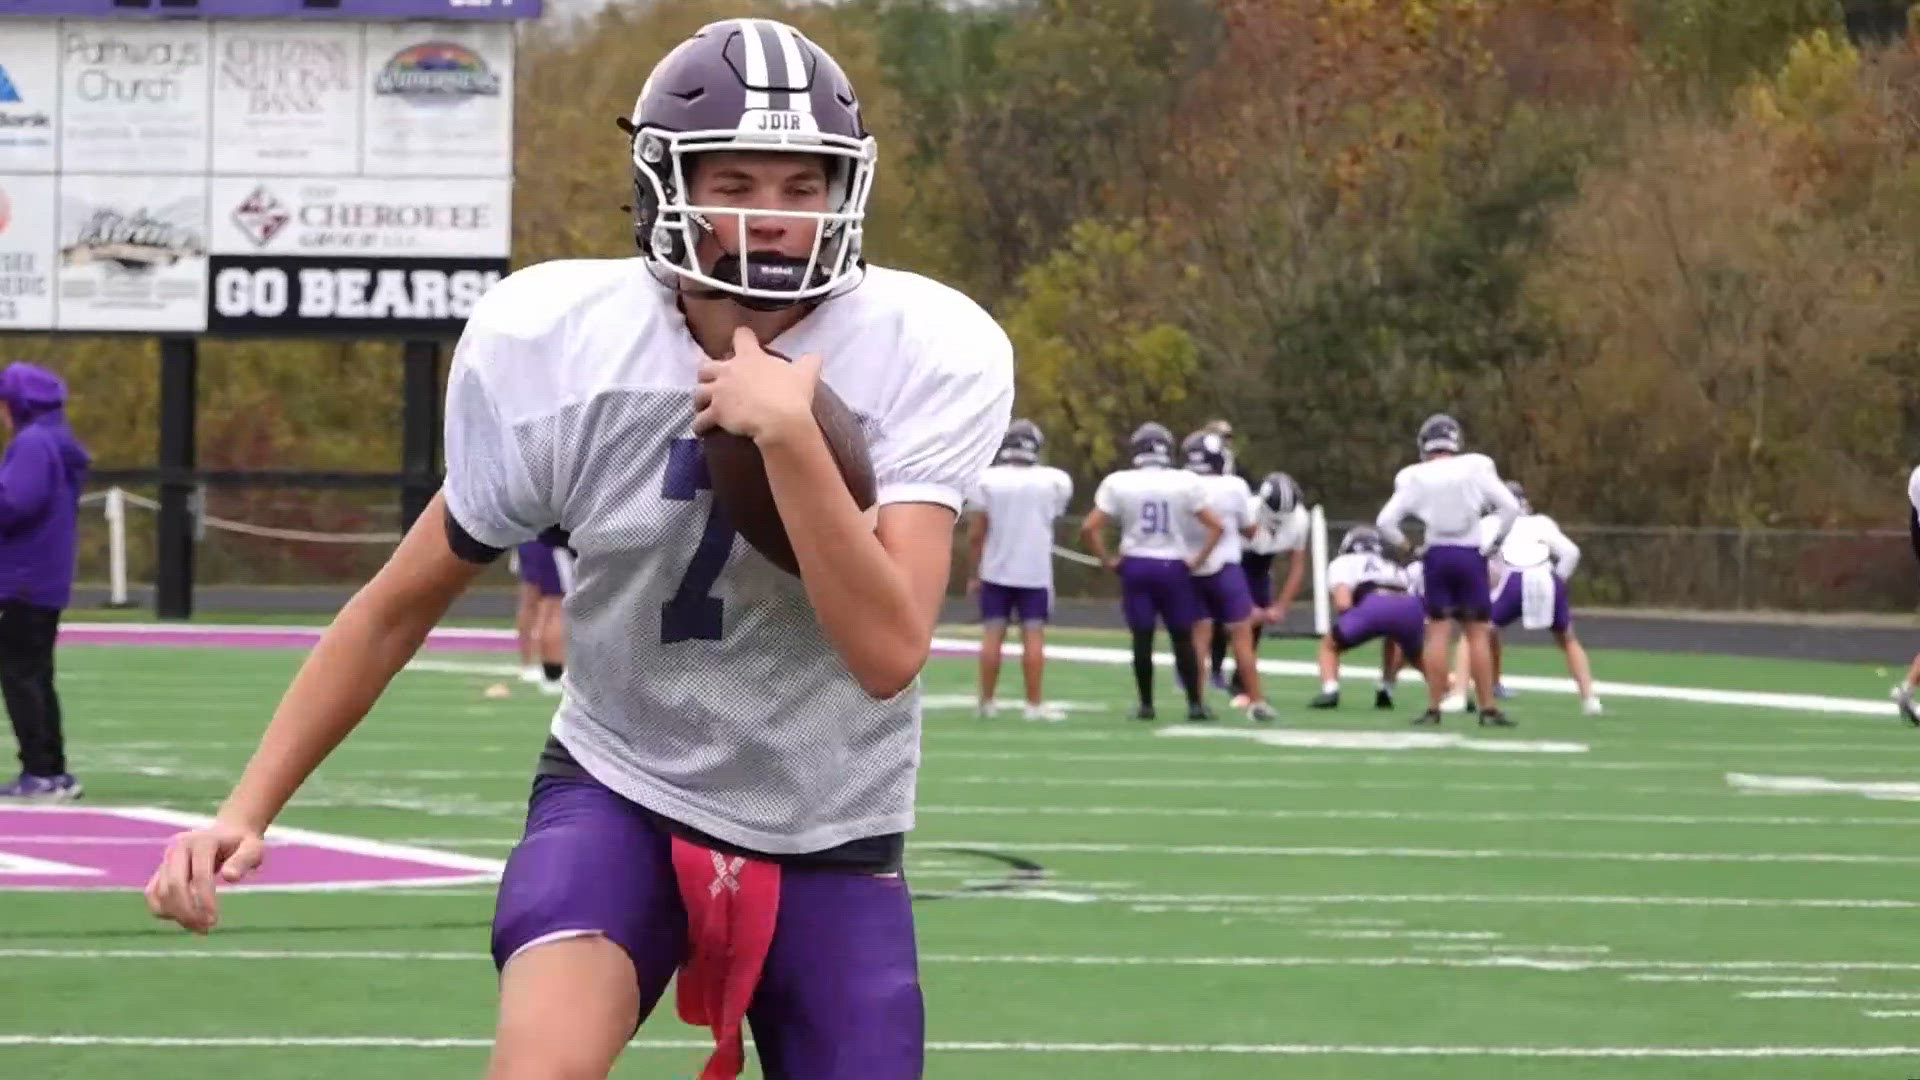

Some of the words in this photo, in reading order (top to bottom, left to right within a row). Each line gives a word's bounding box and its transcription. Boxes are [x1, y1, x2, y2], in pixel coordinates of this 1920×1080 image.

[77, 68, 183, 102] Church
[299, 203, 491, 229] CHEROKEE
[215, 267, 289, 317] GO
[1141, 501, 1170, 535] 91
[660, 437, 738, 644] 7
